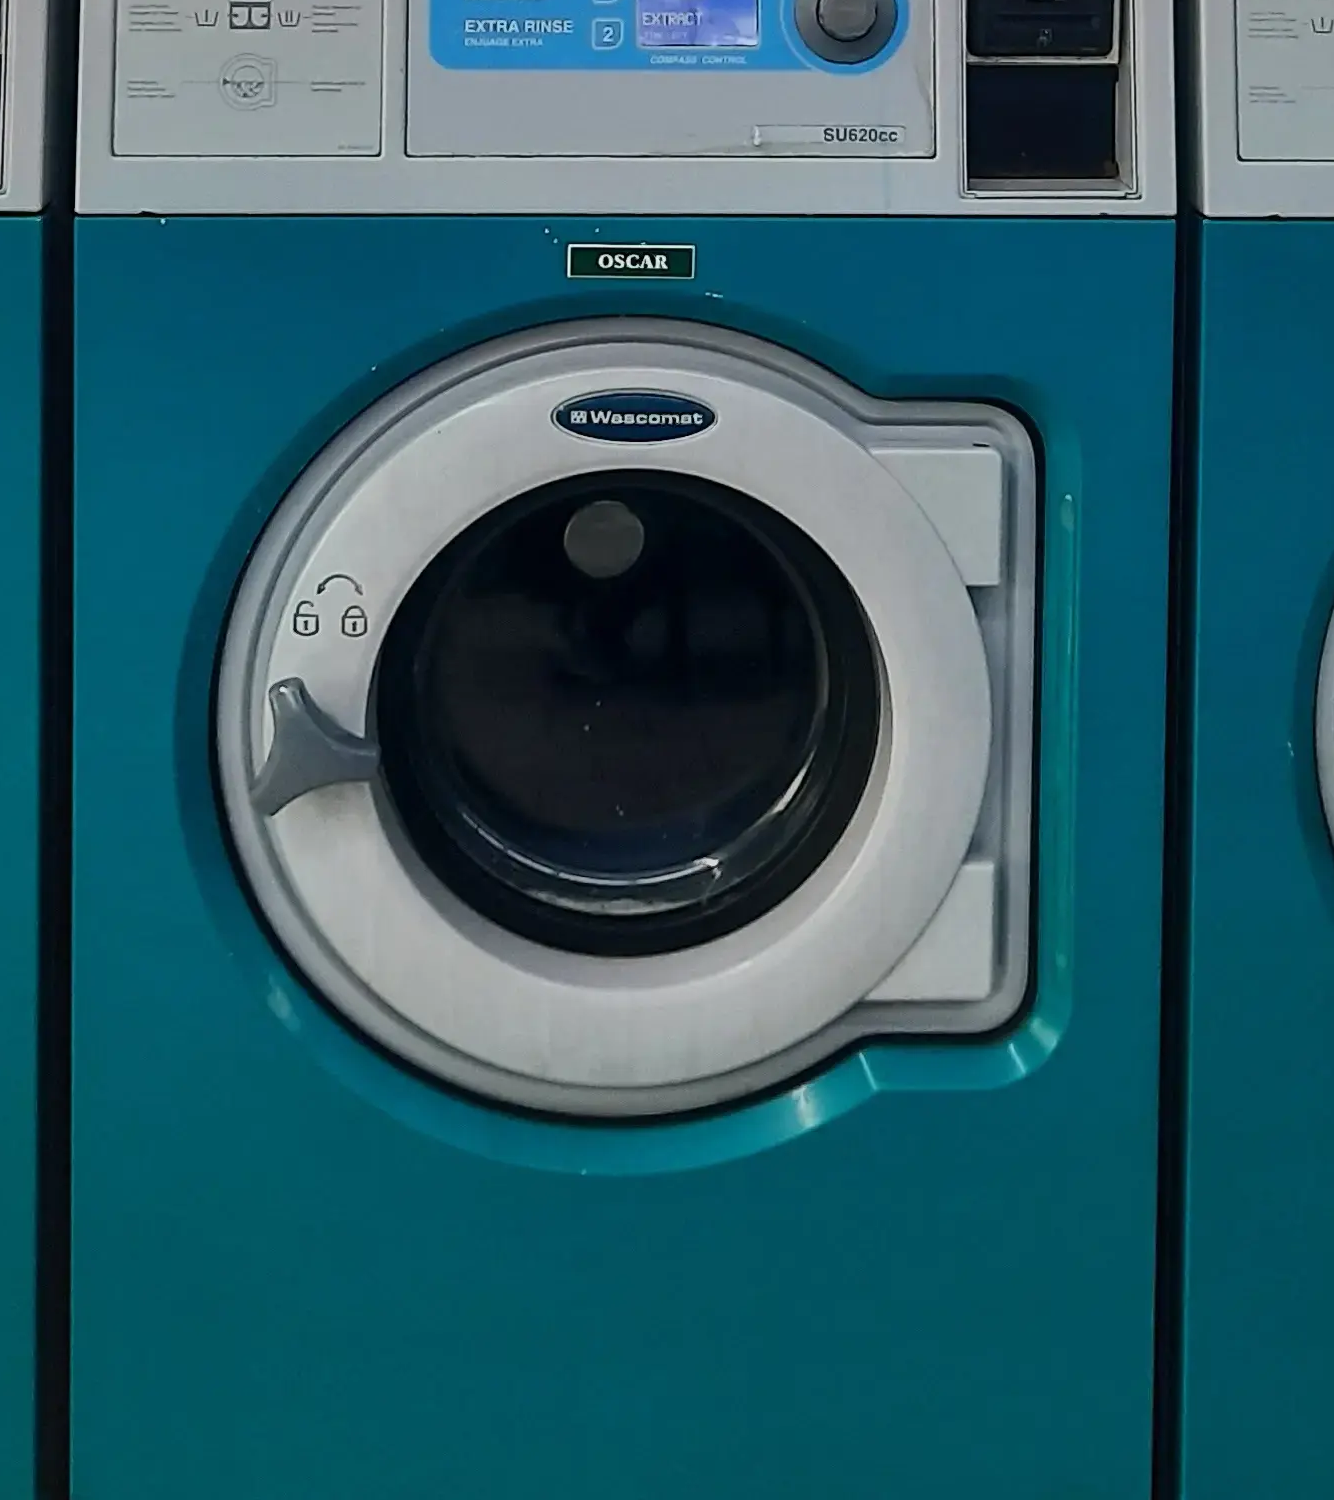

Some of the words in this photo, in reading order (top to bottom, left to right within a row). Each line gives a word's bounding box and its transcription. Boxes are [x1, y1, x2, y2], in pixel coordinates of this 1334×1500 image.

[465, 19, 519, 33] EXTRA
[524, 20, 575, 33] RINSE
[642, 11, 703, 26] EXTRACT
[602, 26, 614, 43] 2
[823, 127, 898, 142] SU620cc
[597, 253, 668, 269] OSCAR
[590, 410, 703, 425] Wascomat
